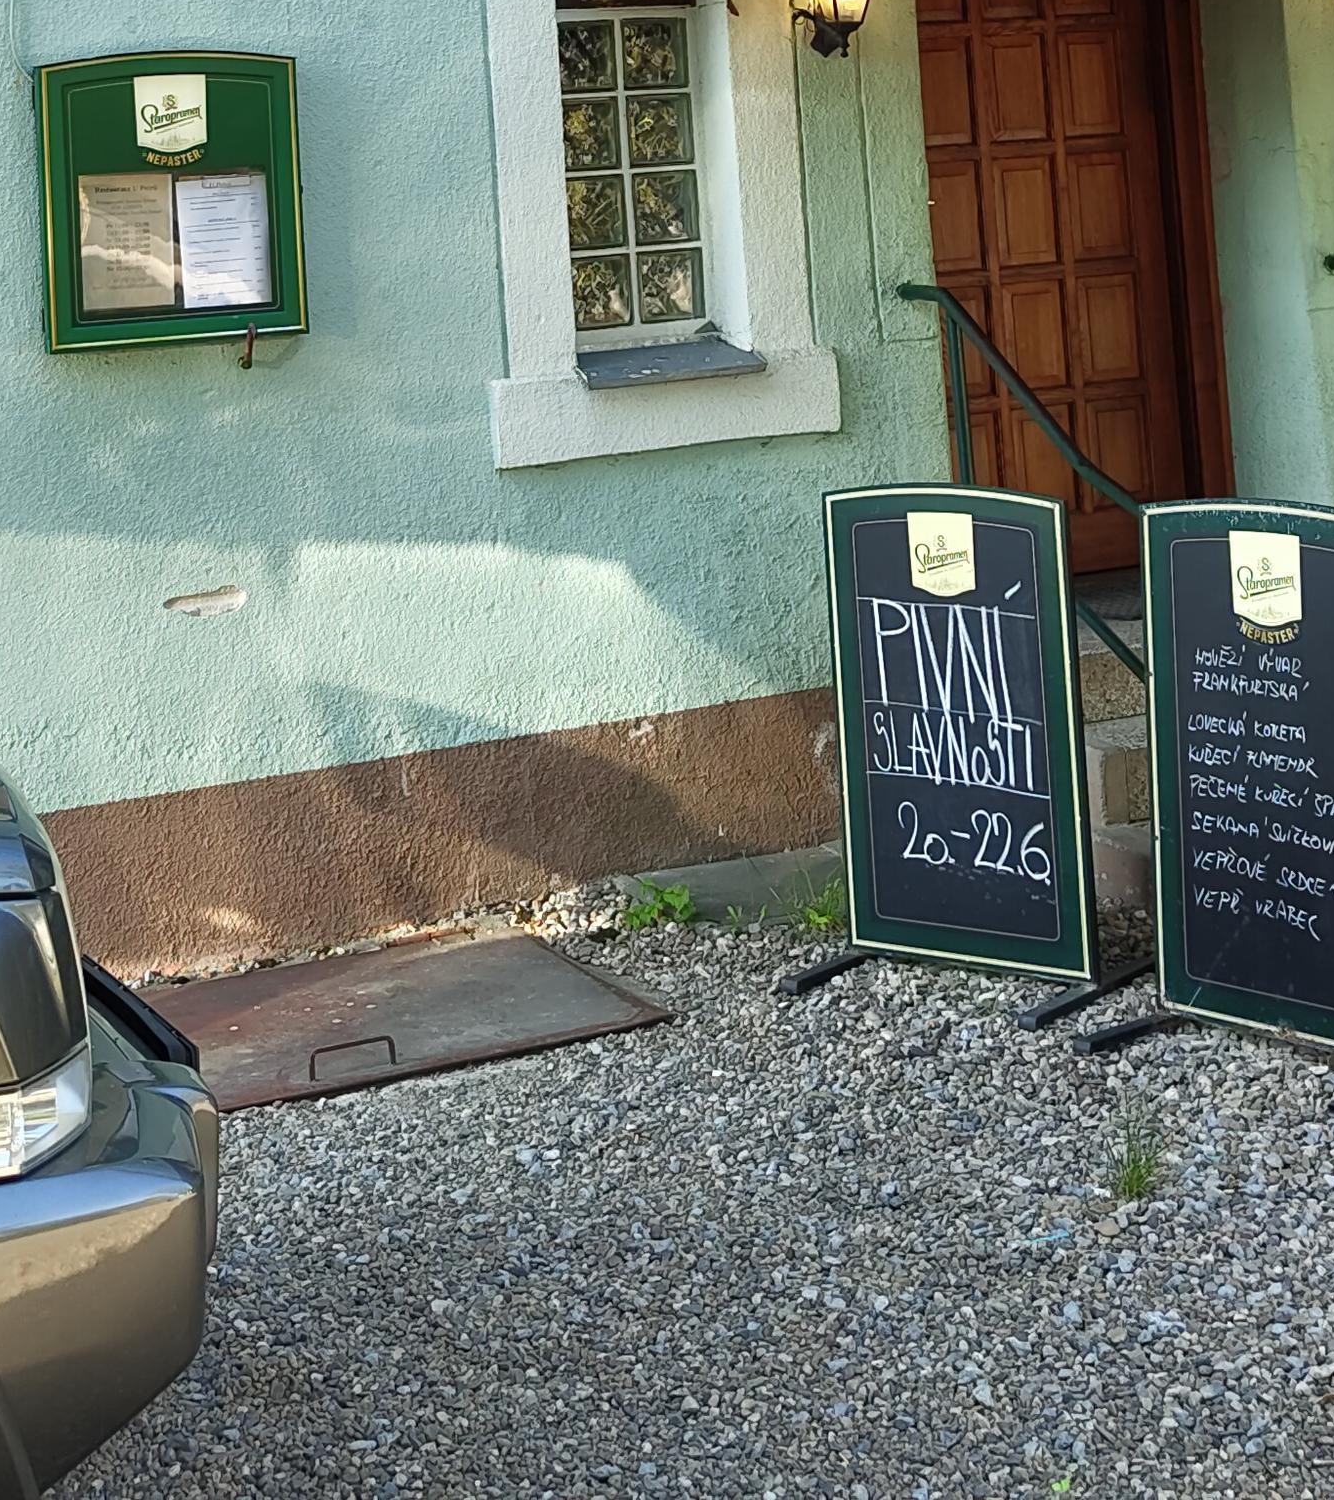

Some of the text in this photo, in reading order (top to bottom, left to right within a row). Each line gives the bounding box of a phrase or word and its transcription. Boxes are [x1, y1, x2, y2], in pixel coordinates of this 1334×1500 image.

[141, 104, 203, 133] Staropramen
[147, 149, 202, 166] NEPASTER
[915, 543, 970, 574] Staropramen
[1237, 566, 1297, 600] Staropramen
[1240, 620, 1296, 645] NEPASTER
[871, 580, 1022, 724] PIVNÍ
[1195, 645, 1246, 668] HOVĚZÍ
[873, 710, 1034, 792] SLAVNOSTI
